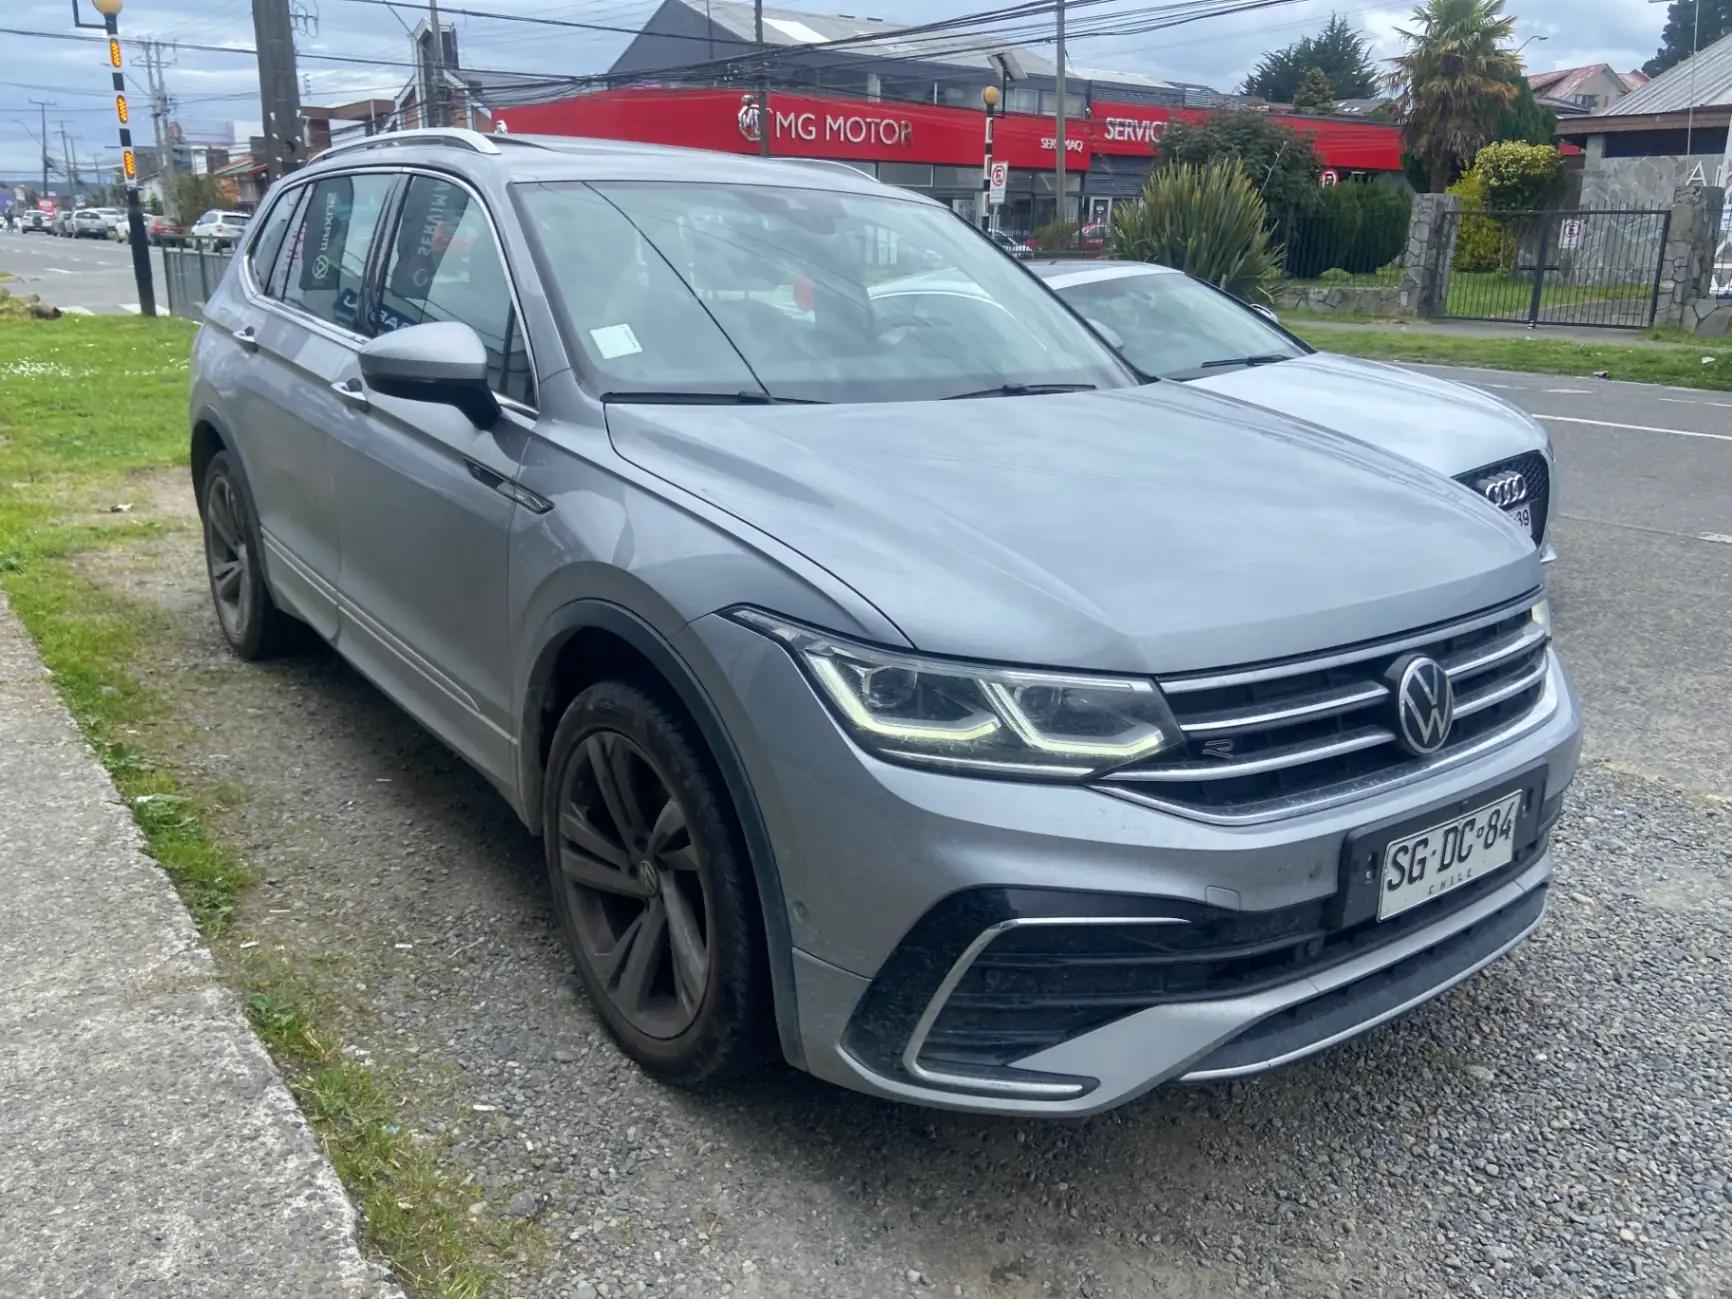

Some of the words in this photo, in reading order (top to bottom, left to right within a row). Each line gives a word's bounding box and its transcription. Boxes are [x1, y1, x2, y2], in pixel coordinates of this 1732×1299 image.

[776, 112, 816, 140] MG
[826, 114, 912, 146] MOTOR
[1040, 138, 1084, 152] SERMAQ
[1428, 867, 1474, 895] CHILE
